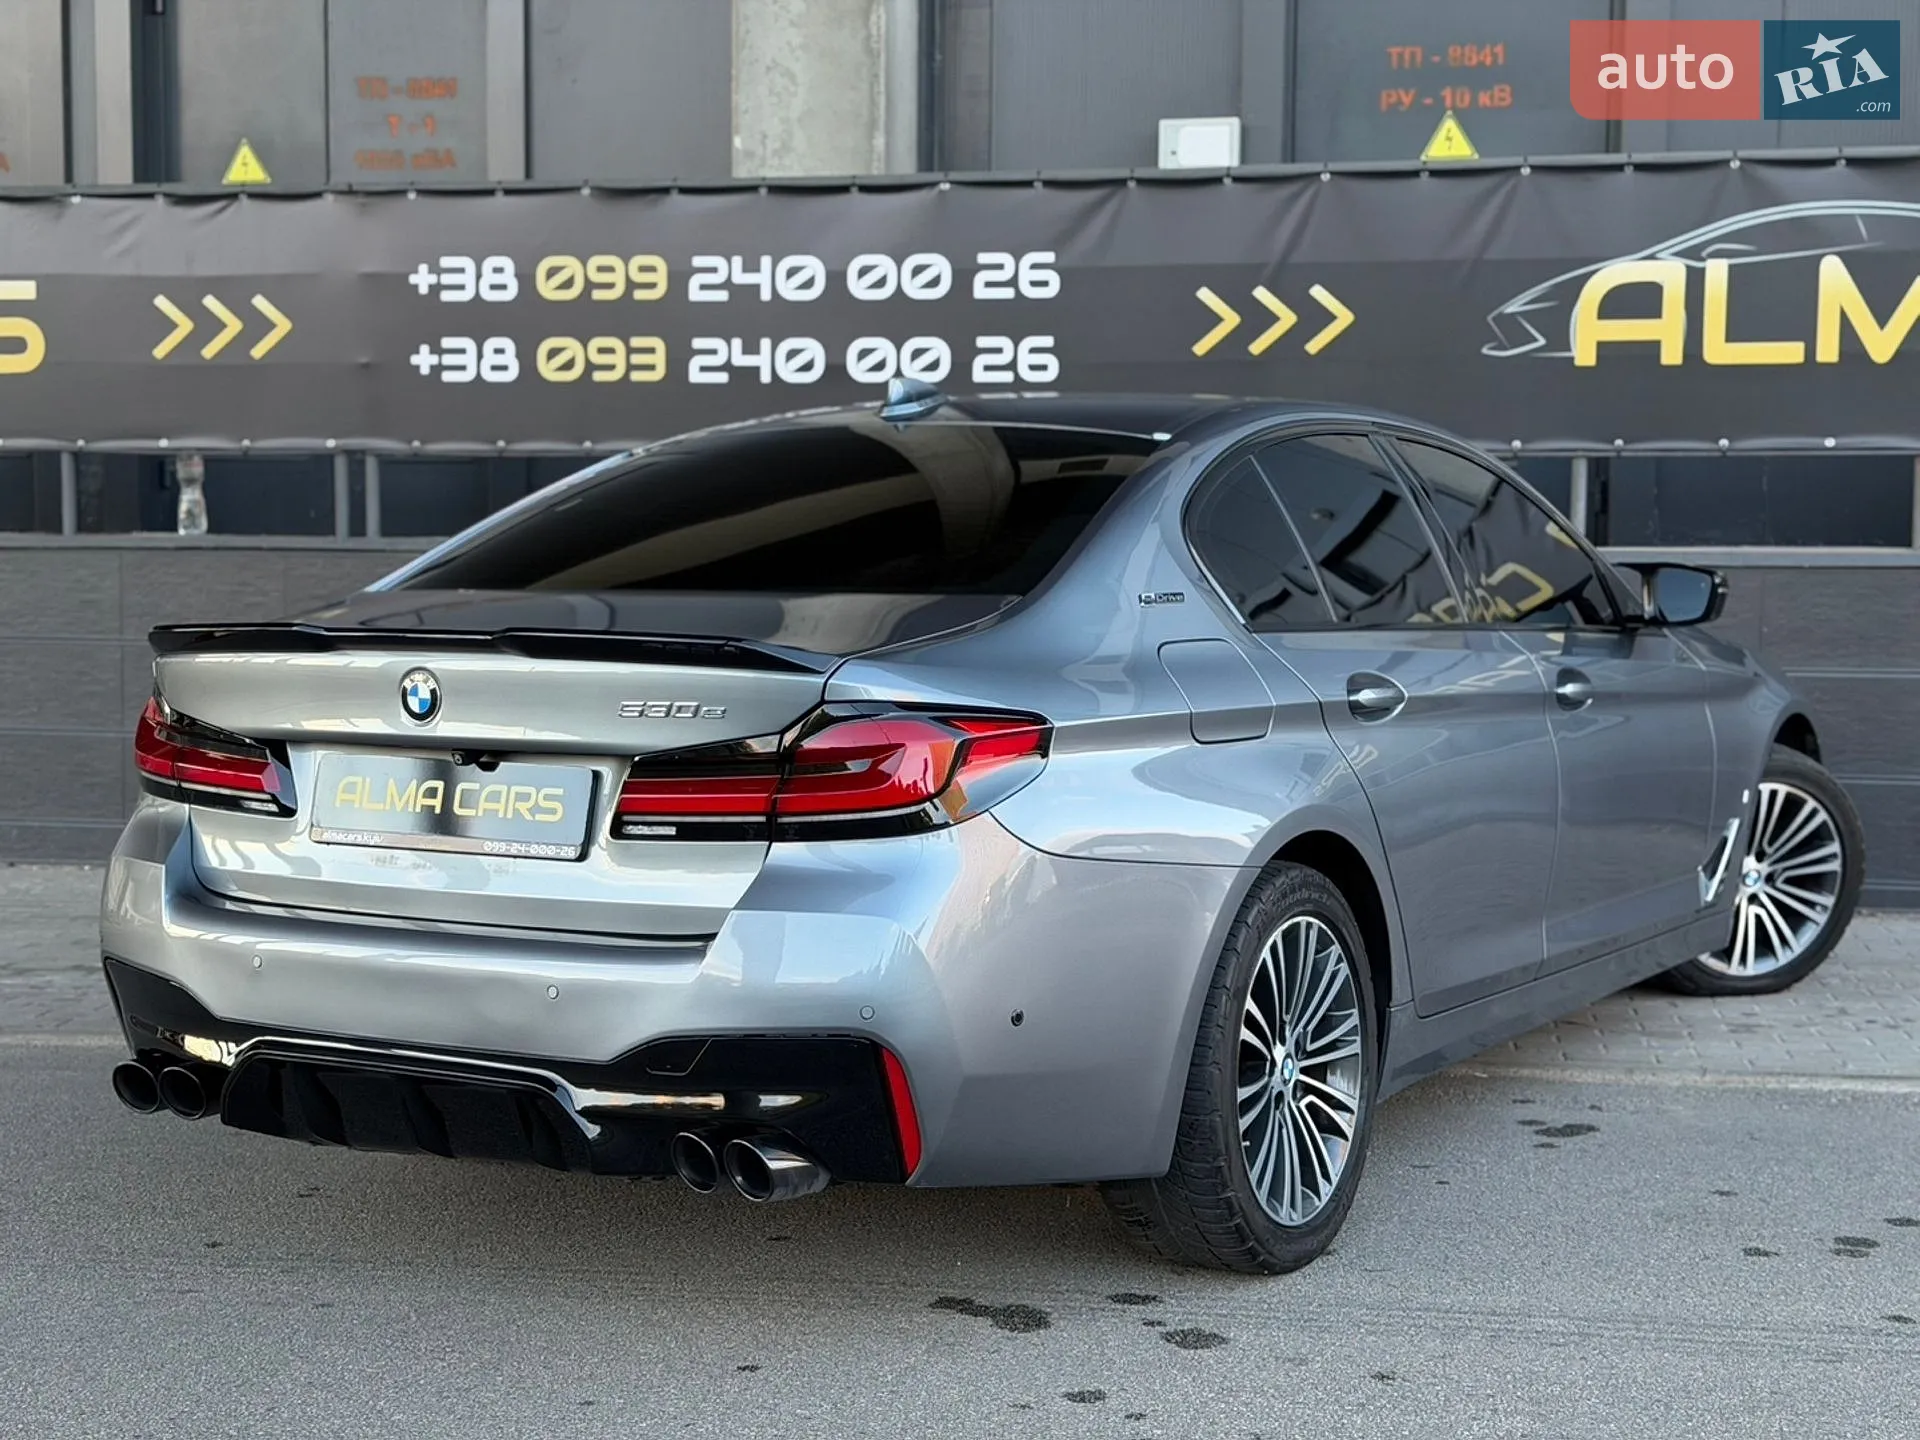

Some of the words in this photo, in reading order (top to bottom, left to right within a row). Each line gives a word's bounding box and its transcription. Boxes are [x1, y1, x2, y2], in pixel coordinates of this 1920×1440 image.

[1440, 86, 1472, 110] 10
[408, 255, 519, 302] +38
[535, 254, 668, 301] 099
[688, 254, 826, 302] 240
[846, 252, 953, 300] 00
[973, 251, 1061, 299] 26
[409, 336, 520, 383] +38
[536, 336, 667, 382] 093
[688, 336, 826, 384] 240
[845, 335, 952, 384] 00
[972, 335, 1060, 384] 26
[619, 701, 727, 719] 530e
[334, 775, 445, 815] ALMA
[453, 781, 565, 823] CARS
